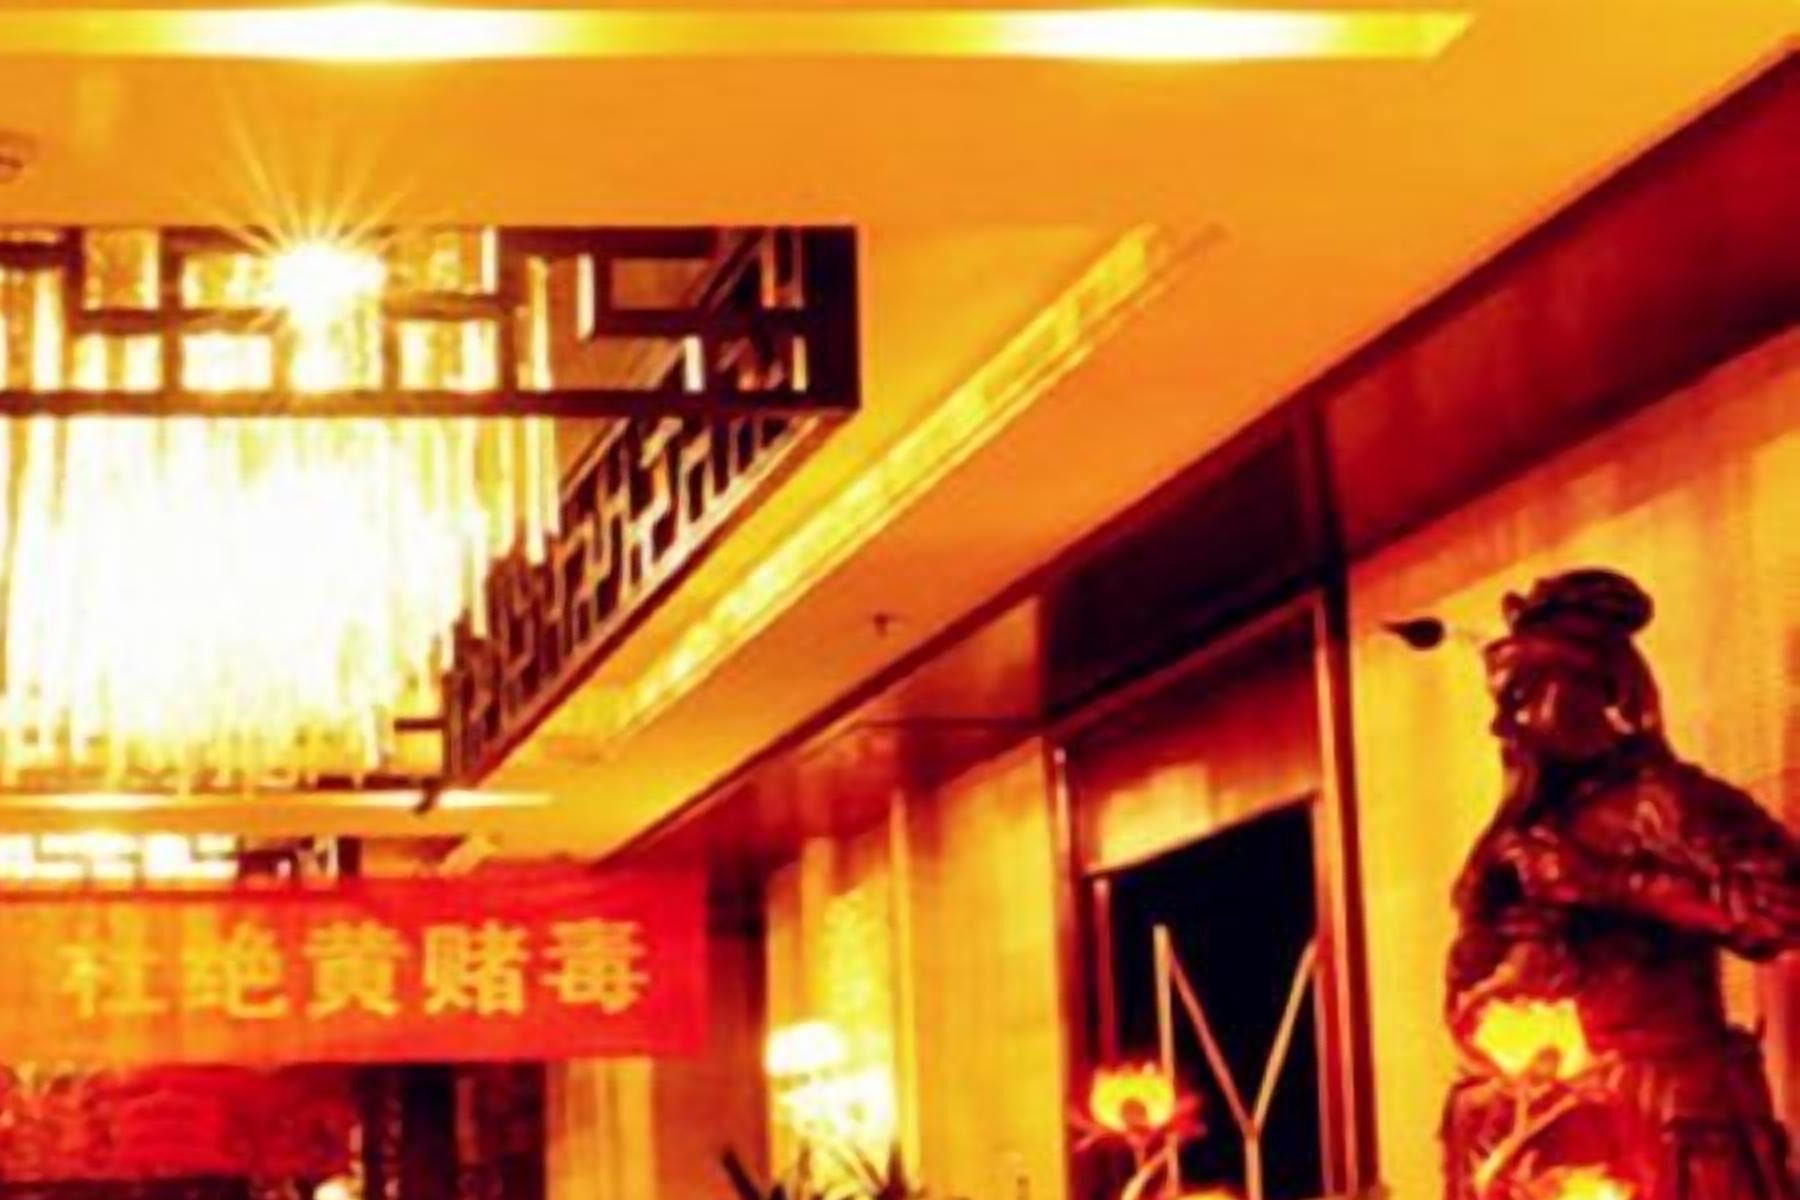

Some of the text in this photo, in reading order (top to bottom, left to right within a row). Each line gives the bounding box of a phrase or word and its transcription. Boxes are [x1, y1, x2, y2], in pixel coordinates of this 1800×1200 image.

[59, 917, 650, 1020] 杜绝黄赌毒
